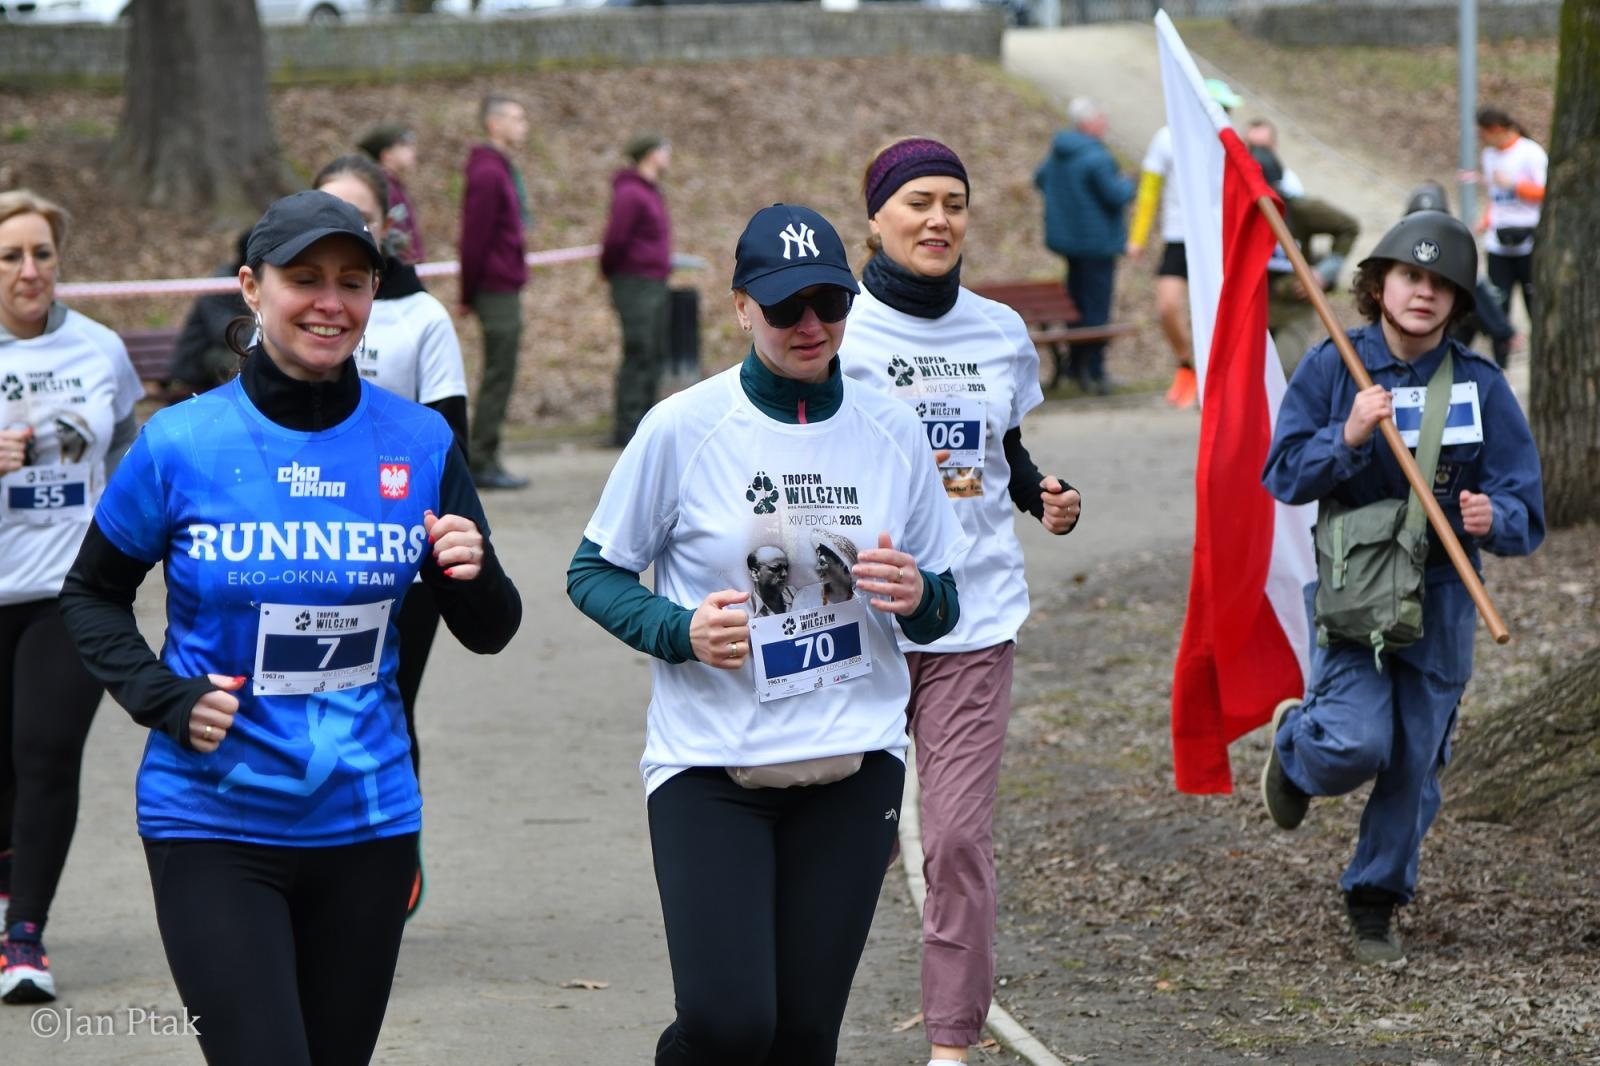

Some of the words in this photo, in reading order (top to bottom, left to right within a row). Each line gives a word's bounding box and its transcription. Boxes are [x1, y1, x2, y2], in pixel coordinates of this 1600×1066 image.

[779, 222, 820, 260] NY
[913, 356, 948, 365] TROPEM
[919, 363, 980, 377] WILCZYM
[967, 383, 987, 392] 2026
[930, 408, 961, 416] WILCZYM
[782, 473, 823, 485] TROPEM
[33, 484, 66, 509] 55
[785, 486, 859, 505] WILCZYM
[788, 515, 803, 526] XIV
[805, 514, 839, 526] EDYCJA
[840, 514, 862, 526] 2026
[188, 521, 426, 564] RUNNERS
[346, 571, 395, 586] TEAM
[799, 611, 819, 620] TROPEM
[800, 613, 836, 631] WILCZYM
[316, 617, 359, 629] WILCZYM
[317, 637, 341, 669] 7
[794, 632, 835, 668] 70
